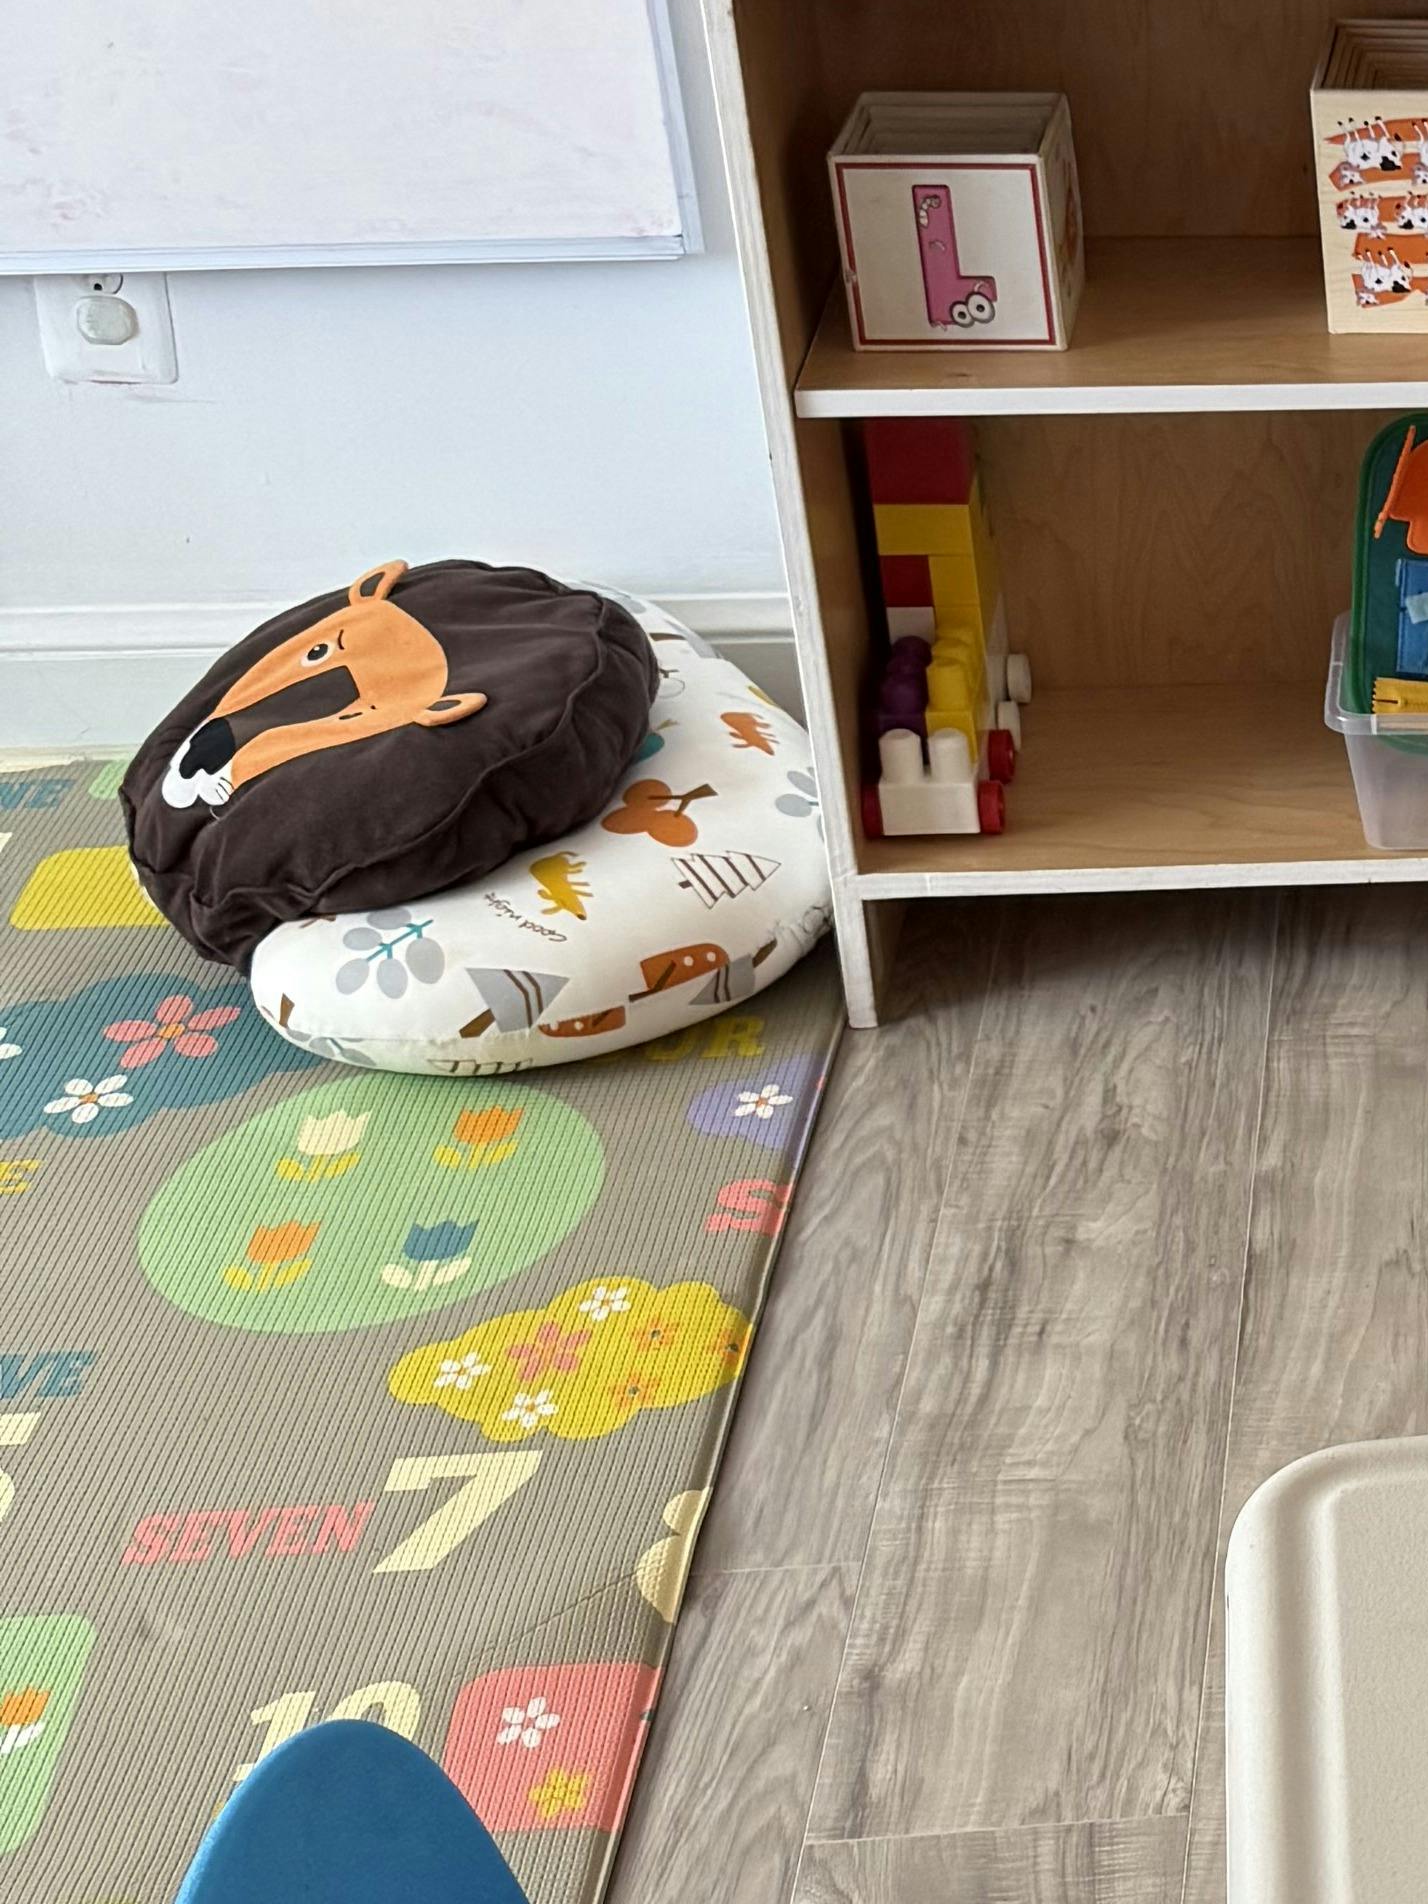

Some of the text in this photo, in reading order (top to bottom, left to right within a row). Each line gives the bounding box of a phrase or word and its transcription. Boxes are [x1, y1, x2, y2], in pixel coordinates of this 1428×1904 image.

[911, 183, 998, 328] L
[120, 1500, 377, 1567] SEVEN
[371, 1450, 544, 1574] 7
